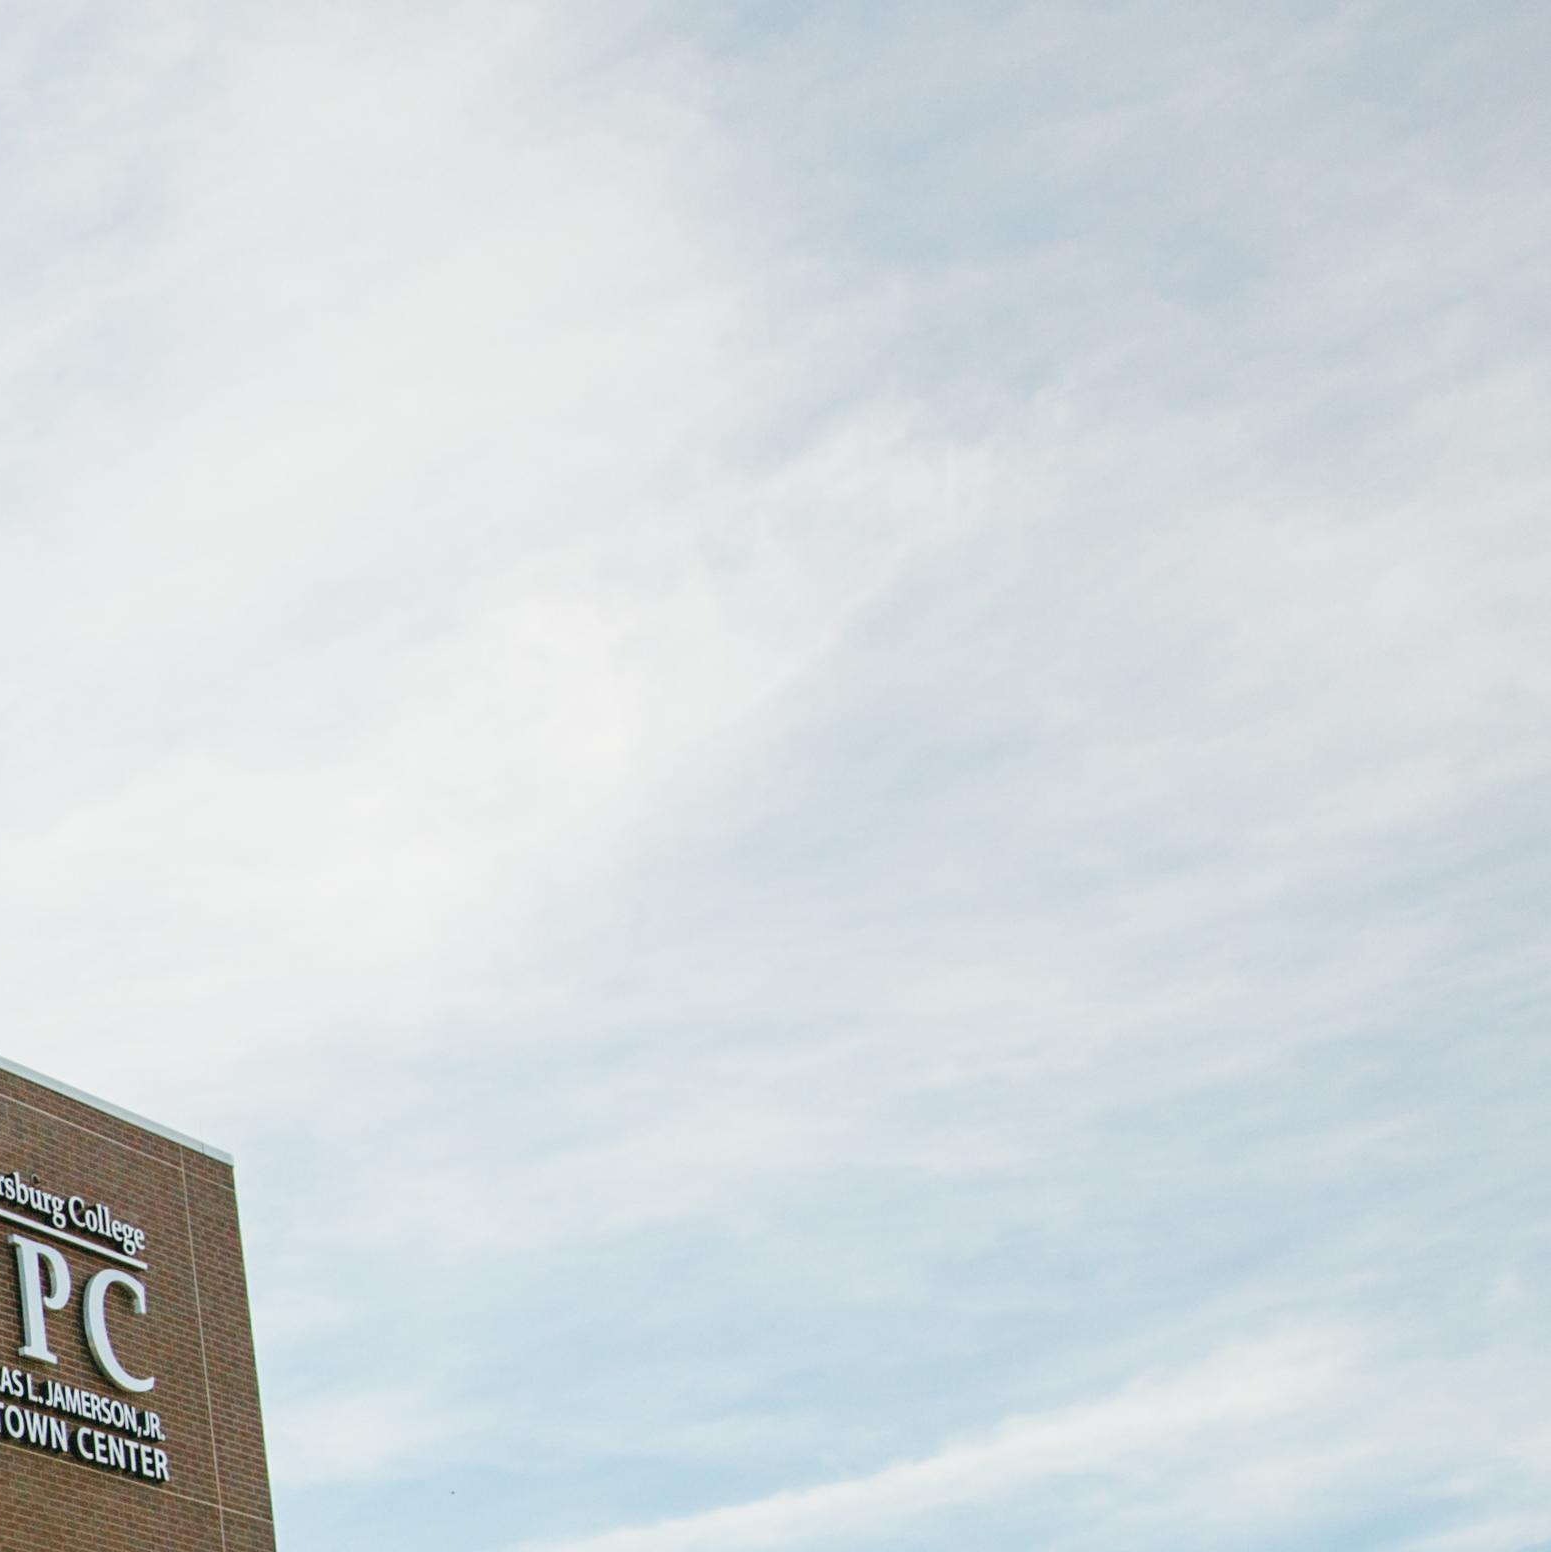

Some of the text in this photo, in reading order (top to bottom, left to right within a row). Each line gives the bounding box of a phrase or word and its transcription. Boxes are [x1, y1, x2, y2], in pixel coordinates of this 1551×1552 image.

[68, 1196, 146, 1256] College
[27, 1373, 45, 1405] L.
[143, 1411, 166, 1441] JR.
[77, 1426, 170, 1482] CENTER
